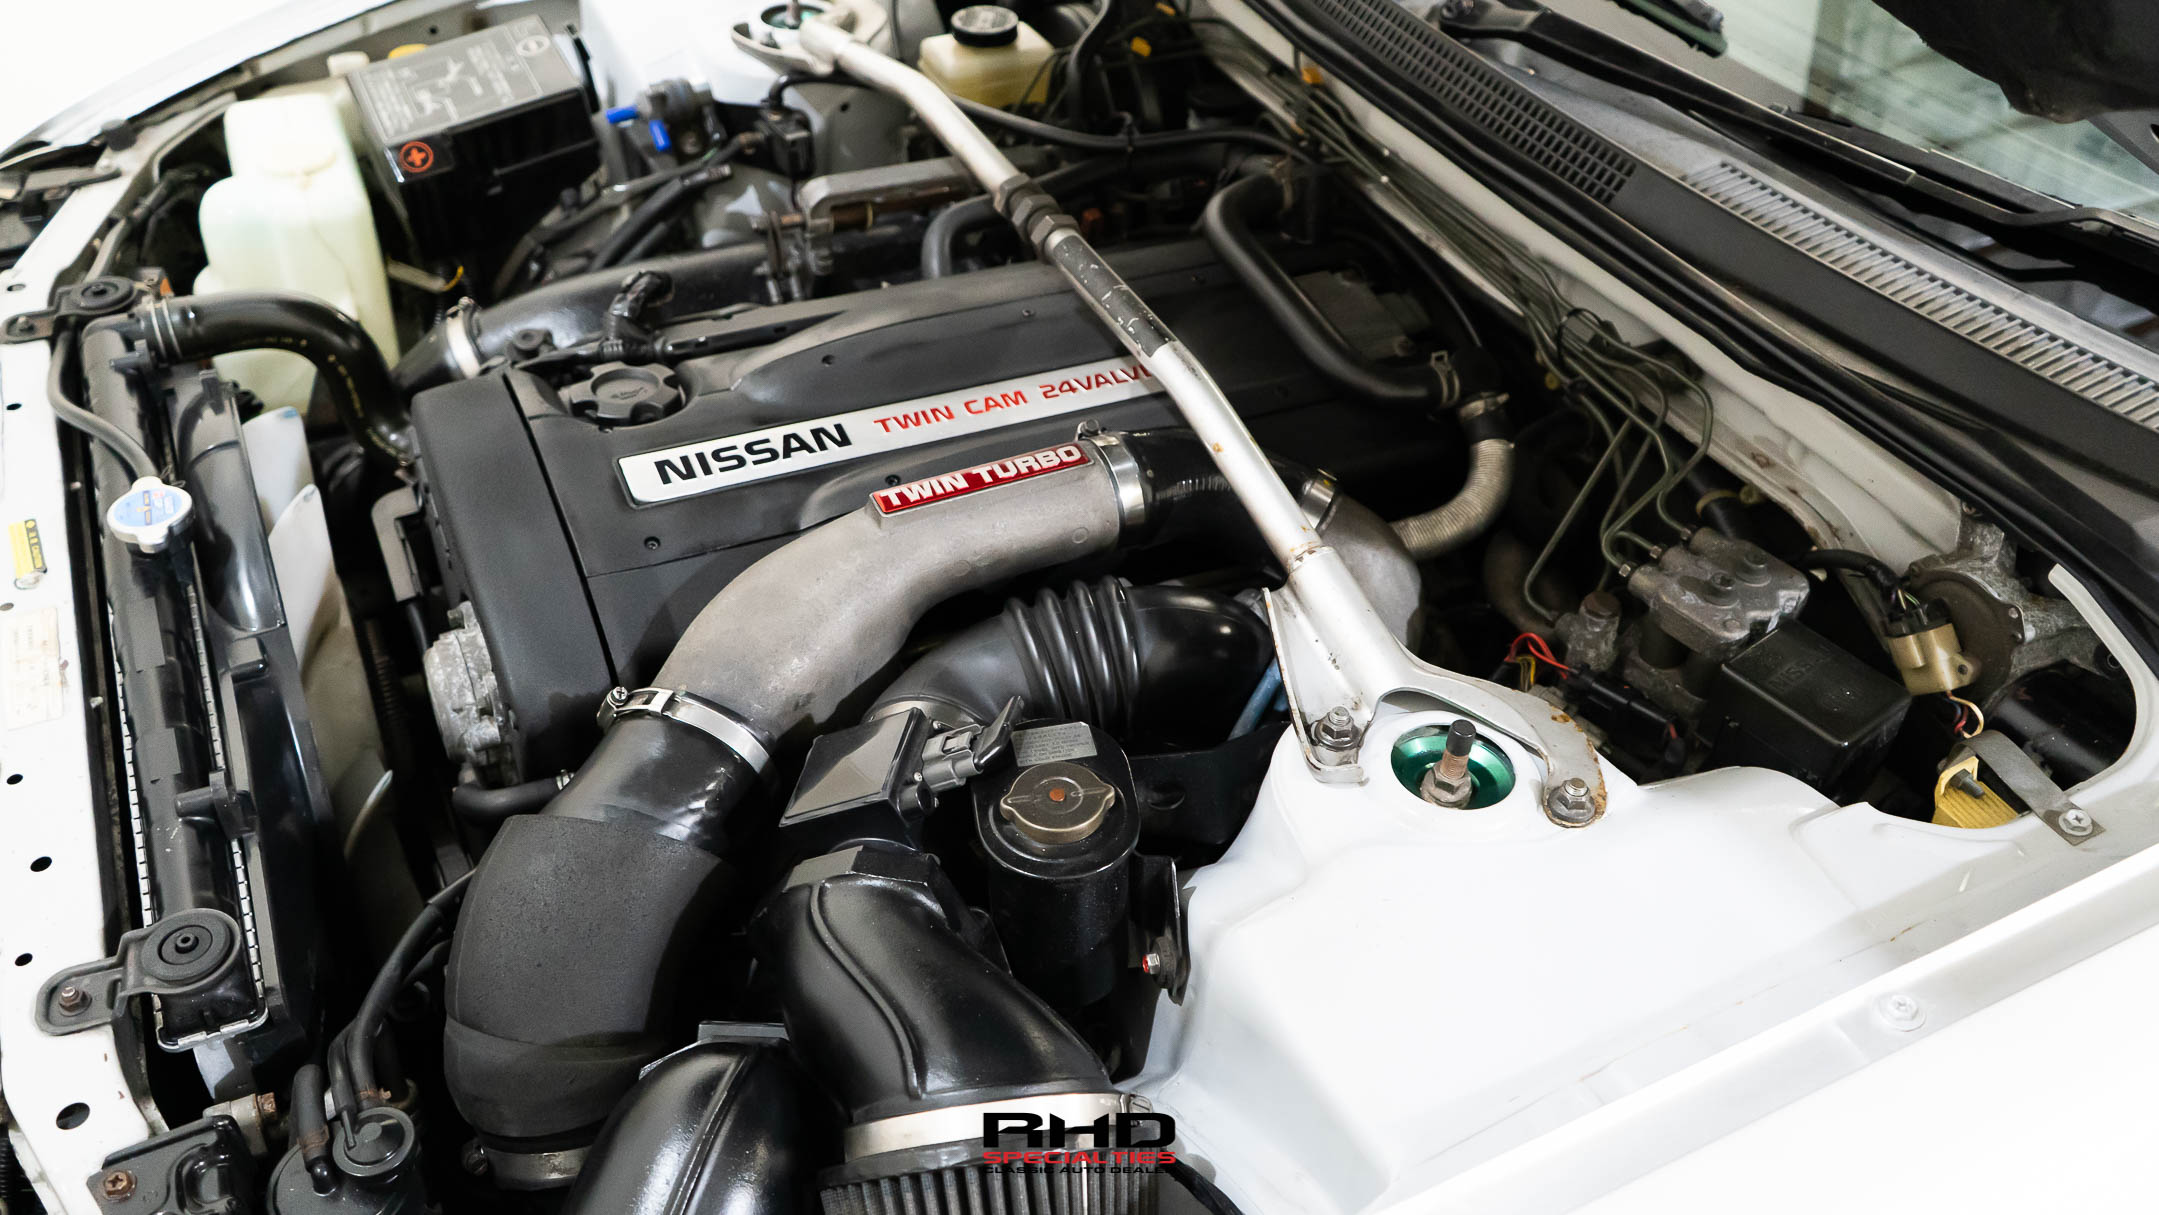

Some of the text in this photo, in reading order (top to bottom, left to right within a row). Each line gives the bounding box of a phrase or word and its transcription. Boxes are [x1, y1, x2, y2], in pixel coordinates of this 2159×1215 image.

[655, 424, 852, 485] NISSAN
[874, 404, 956, 433] TWIN
[963, 389, 1028, 416] CAM
[880, 445, 1083, 507] TWIN TURBO
